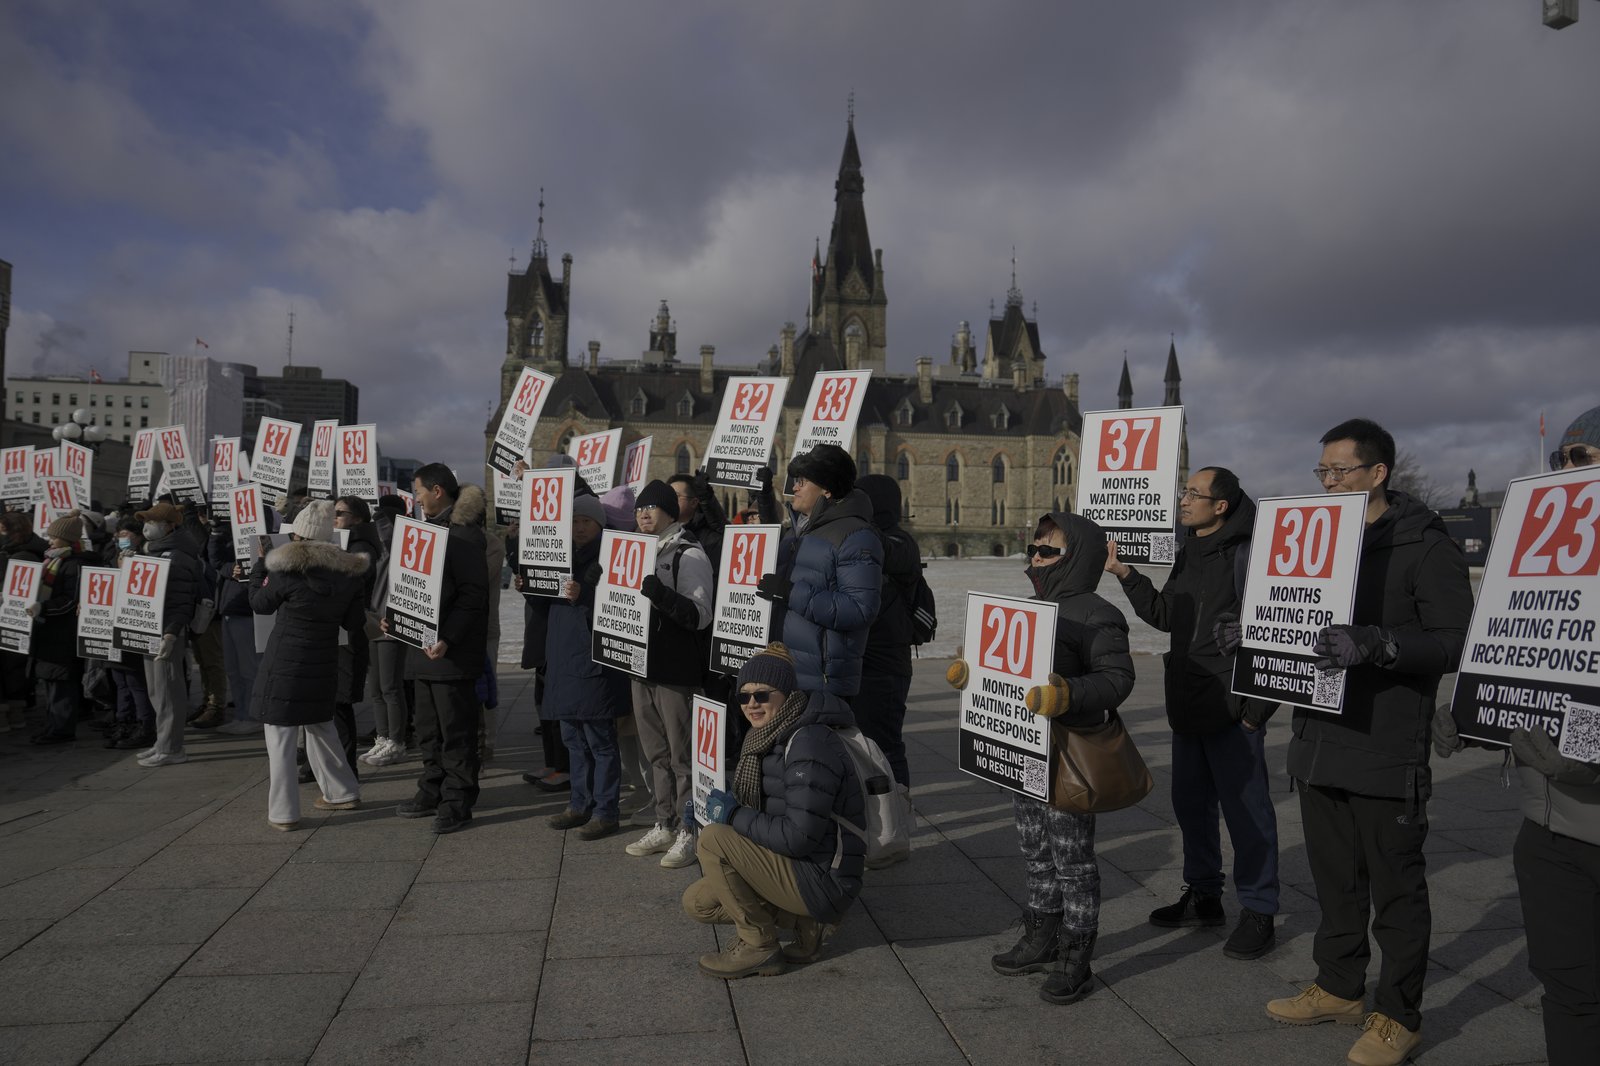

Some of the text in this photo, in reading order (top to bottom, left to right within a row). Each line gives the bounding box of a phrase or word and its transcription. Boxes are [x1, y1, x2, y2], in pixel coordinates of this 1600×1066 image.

[516, 376, 542, 414] 38
[735, 383, 769, 420] 32
[818, 378, 852, 420] 33
[266, 424, 291, 456] 37
[730, 424, 759, 434] MONTHS
[811, 426, 838, 437] MONTHS
[164, 431, 182, 459] 36
[317, 426, 330, 457] 90
[345, 430, 367, 464] 39
[580, 437, 607, 466] 37
[714, 445, 766, 458] IRCC RESPONSE
[720, 435, 764, 446] WAITING FOR
[1105, 419, 1154, 470] 37
[8, 451, 23, 474] 11
[36, 454, 51, 477] 27
[68, 447, 83, 476] 16
[215, 443, 232, 472] 28
[263, 456, 282, 467] MONTHS
[627, 446, 643, 482] 30
[716, 462, 754, 471] NO TIMELINES
[276, 468, 285, 477] FOR
[346, 468, 366, 476] MONTHS
[594, 474, 606, 483] FOR
[716, 471, 750, 482] NO RESULTS
[1102, 477, 1149, 489] MONTHS
[49, 481, 71, 509] 31
[532, 478, 559, 521] 38
[1090, 493, 1161, 506] WAITING FOR
[237, 490, 255, 524] 31
[1082, 509, 1167, 522] IRCC RESPONSE
[532, 526, 556, 536] MONTHS
[1105, 531, 1152, 543] TIMELINES
[1517, 481, 1600, 575] 23
[404, 527, 432, 574] 37
[526, 538, 563, 549] WAITING FOR
[1117, 545, 1149, 556] ESULTS
[1275, 507, 1332, 577] 30
[522, 550, 567, 562] IRCC RESPONSE
[612, 540, 640, 588] 40
[732, 534, 760, 584] 31
[11, 566, 31, 597] 14
[130, 562, 156, 596] 37
[402, 573, 426, 590] MONTHS
[527, 568, 560, 579] NO TIMELINES
[90, 574, 112, 605] 37
[394, 583, 432, 605] WAITING FOR
[529, 579, 558, 591] NO RESULTS
[1269, 585, 1321, 604] MONTHS
[128, 599, 151, 609] MONTHS
[389, 594, 434, 619] IRCC RESPONSE
[609, 591, 636, 605] MONTHS
[728, 591, 755, 605] MONTHS
[1508, 589, 1581, 612] MONTHS
[121, 608, 156, 620] WAITING FOR
[393, 613, 401, 623] NO
[602, 603, 641, 622] WAITING FOR
[721, 605, 761, 622] WAITING FOR
[1255, 605, 1333, 627] WAITING FOR
[91, 627, 112, 636] RESPON
[129, 618, 158, 630] RESPONSE
[395, 623, 424, 640] NO RESULTS
[597, 616, 644, 637] IRCC RESPONSE
[717, 620, 764, 639] IRCC RESPONSE
[1487, 616, 1596, 642] WAITING FOR
[601, 636, 632, 653] NO TIMELINE
[983, 607, 1029, 676] 20
[1246, 625, 1318, 647] IRCC RESPON
[603, 648, 632, 665] NO RESULTS
[720, 643, 727, 653] NO
[1470, 643, 1600, 674] IRCC RESPONSE
[720, 656, 728, 666] NO
[1252, 655, 1315, 676] NO TIMELINE
[982, 678, 1024, 702] MONTHS
[1254, 673, 1314, 695] NO RESULTS
[972, 693, 1035, 724] WAITING FOR
[1476, 683, 1573, 712] NO TIMELINES
[1476, 706, 1496, 726] NO
[699, 708, 716, 769] 22
[965, 710, 1042, 746] IRCC RESPONSE
[973, 738, 1024, 766] NO TIMELINE
[976, 755, 1024, 782] NO RESULTS
